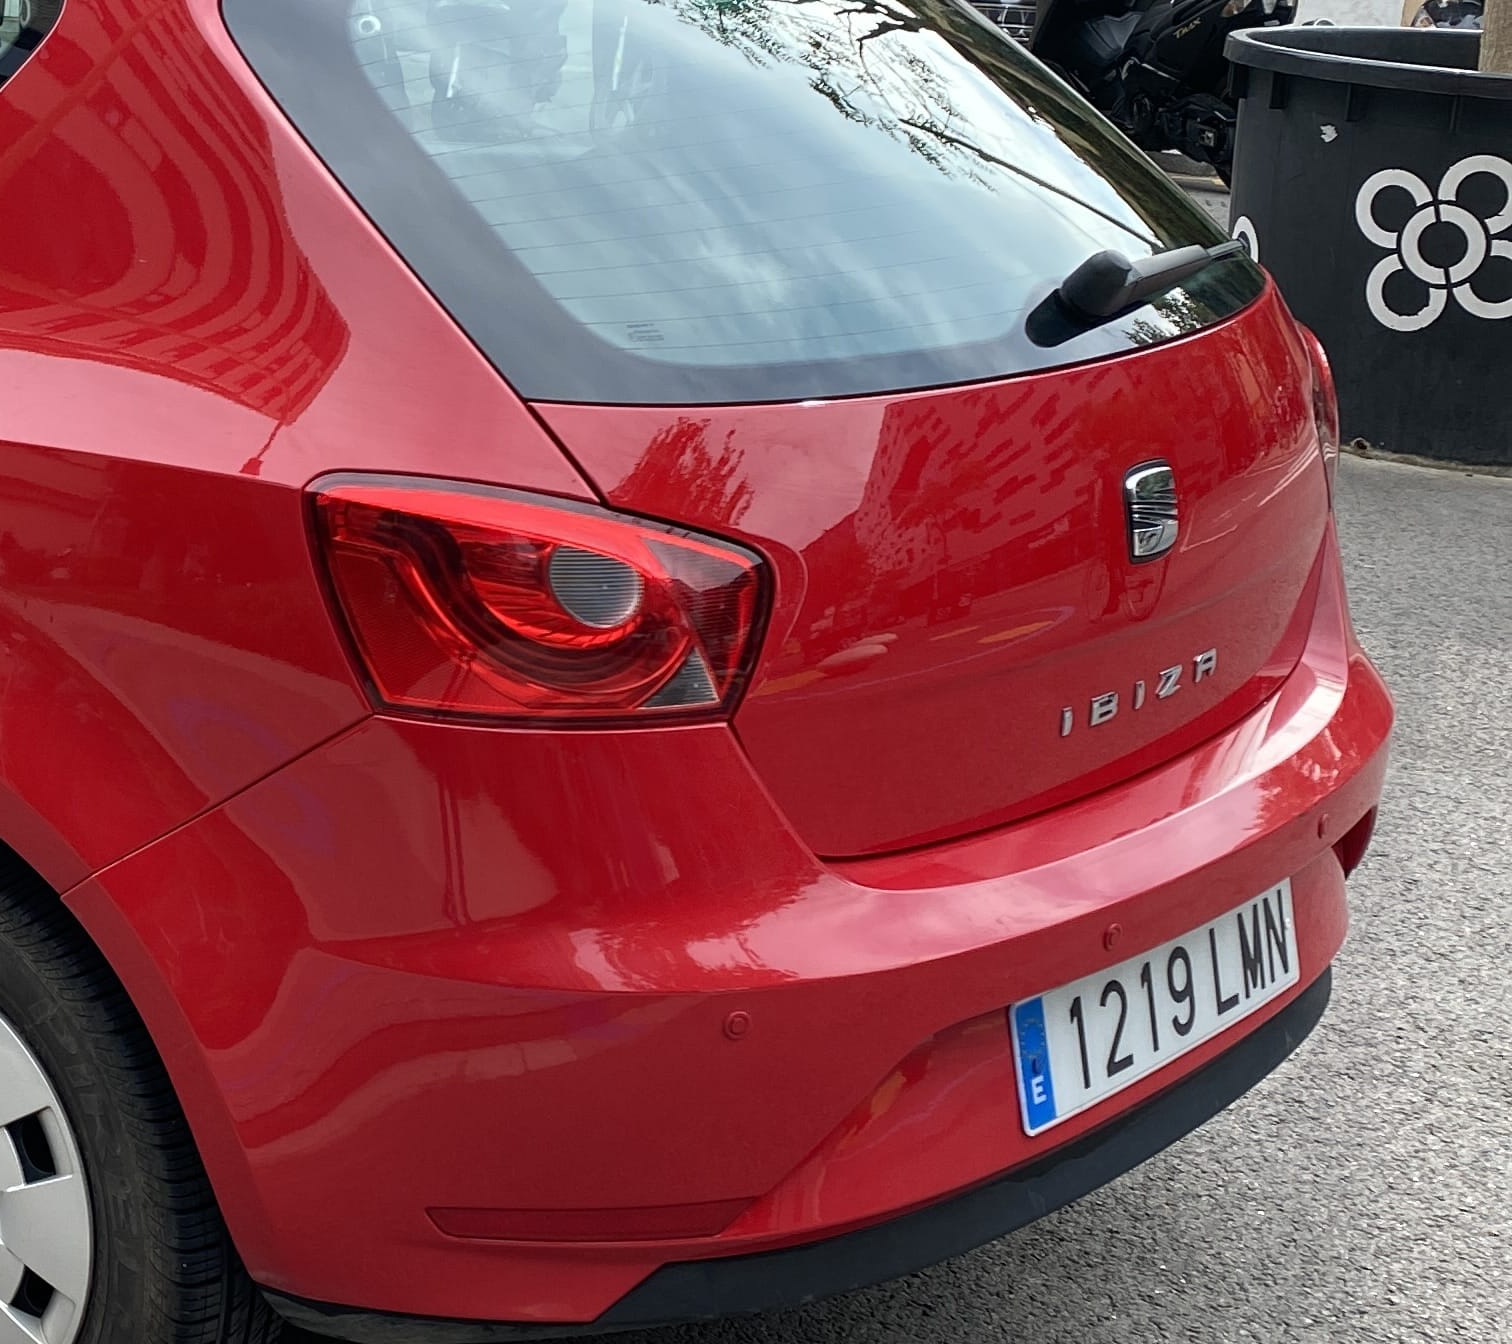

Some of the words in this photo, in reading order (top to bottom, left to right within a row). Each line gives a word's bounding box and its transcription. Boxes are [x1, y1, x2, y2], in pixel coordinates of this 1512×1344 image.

[1060, 648, 1218, 738] IBIZA
[1031, 1074, 1048, 1105] E
[1069, 945, 1196, 1089] 1219
[1208, 887, 1290, 1016] LMN
